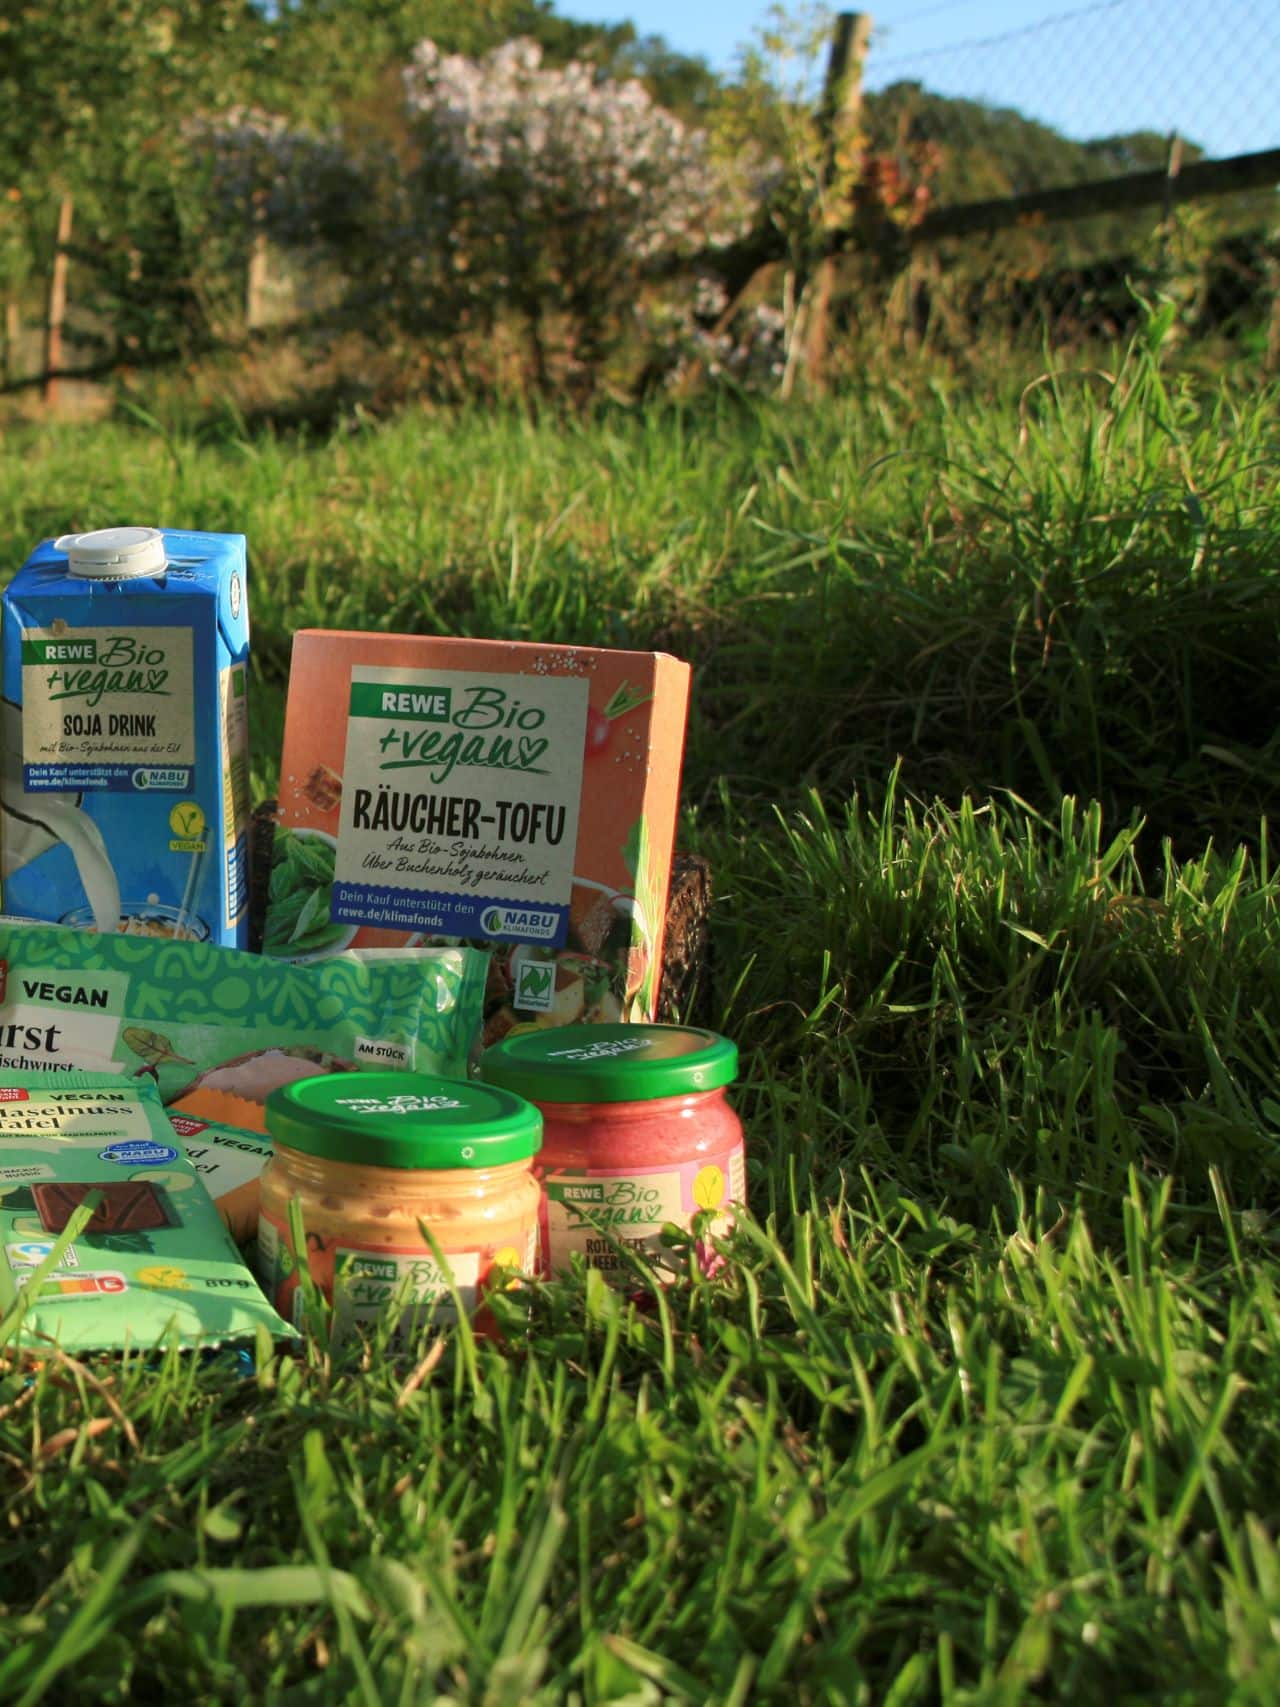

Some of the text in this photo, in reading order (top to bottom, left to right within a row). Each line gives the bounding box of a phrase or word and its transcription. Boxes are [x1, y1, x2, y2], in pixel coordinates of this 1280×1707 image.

[45, 637, 165, 667] REWE Bio
[381, 686, 546, 730] REWE Bio
[63, 714, 156, 737] SOJA DRINK
[29, 767, 129, 777] Dein Kauf unterstützt den
[150, 771, 186, 781] NABU
[353, 784, 567, 846] RÄUCHER-TOFU
[386, 836, 526, 864] Aus Bio-Sojabohnen
[361, 851, 549, 888] Über Buchenholz geräuchert
[339, 889, 475, 914] Dein Kauf unterstützt den
[338, 907, 443, 927] rewe.de/klimafonds
[504, 911, 555, 928] NABU
[503, 924, 551, 936] KLIMAFONDS
[22, 980, 109, 1008] VEGAN
[358, 1044, 405, 1060] AM STÜCK
[563, 1182, 660, 1205] REWE Bio
[206, 1279, 232, 1288] 80
